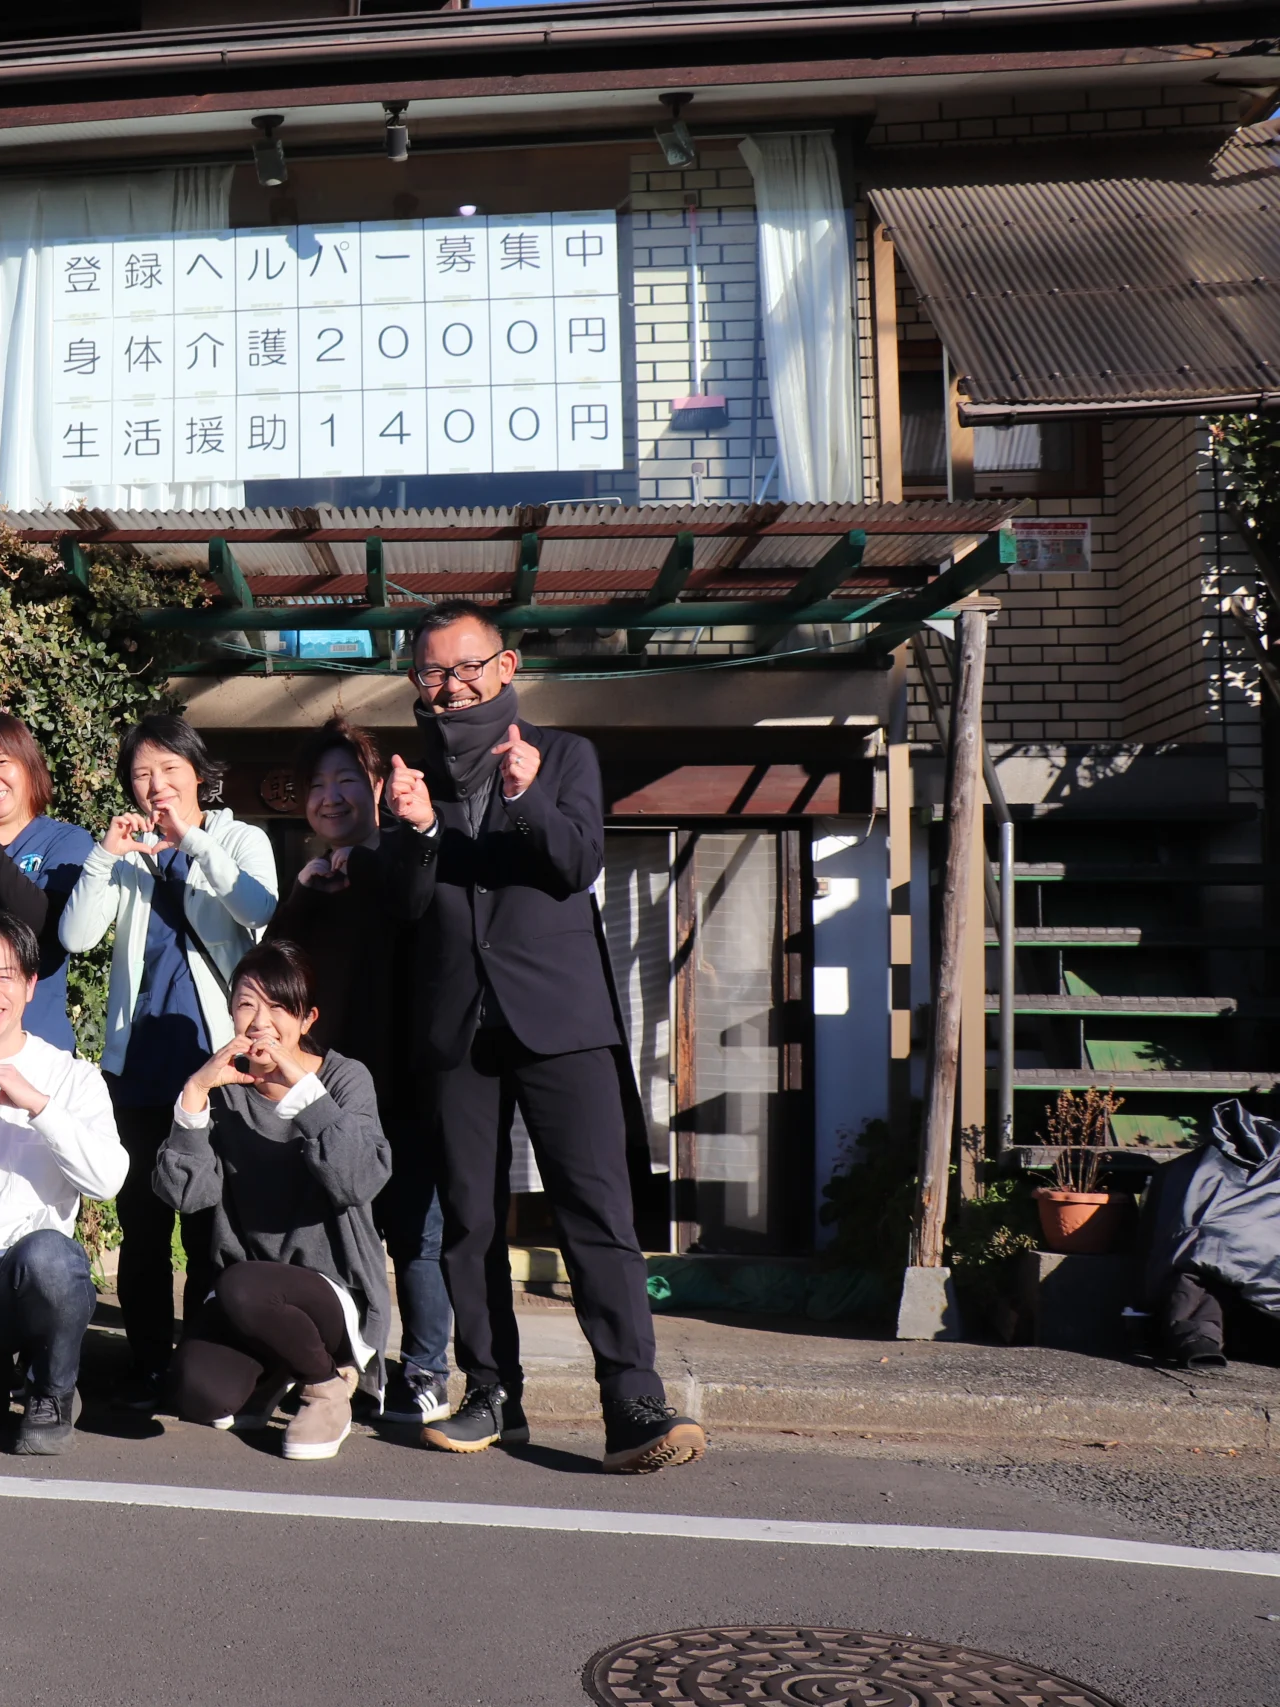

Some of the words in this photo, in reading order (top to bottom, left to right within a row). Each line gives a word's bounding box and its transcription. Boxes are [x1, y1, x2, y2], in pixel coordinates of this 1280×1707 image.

[64, 229, 604, 294] 登録ヘルパー募集中
[63, 317, 606, 375] 身体介護2000円
[62, 404, 609, 459] 生活援助1400円
